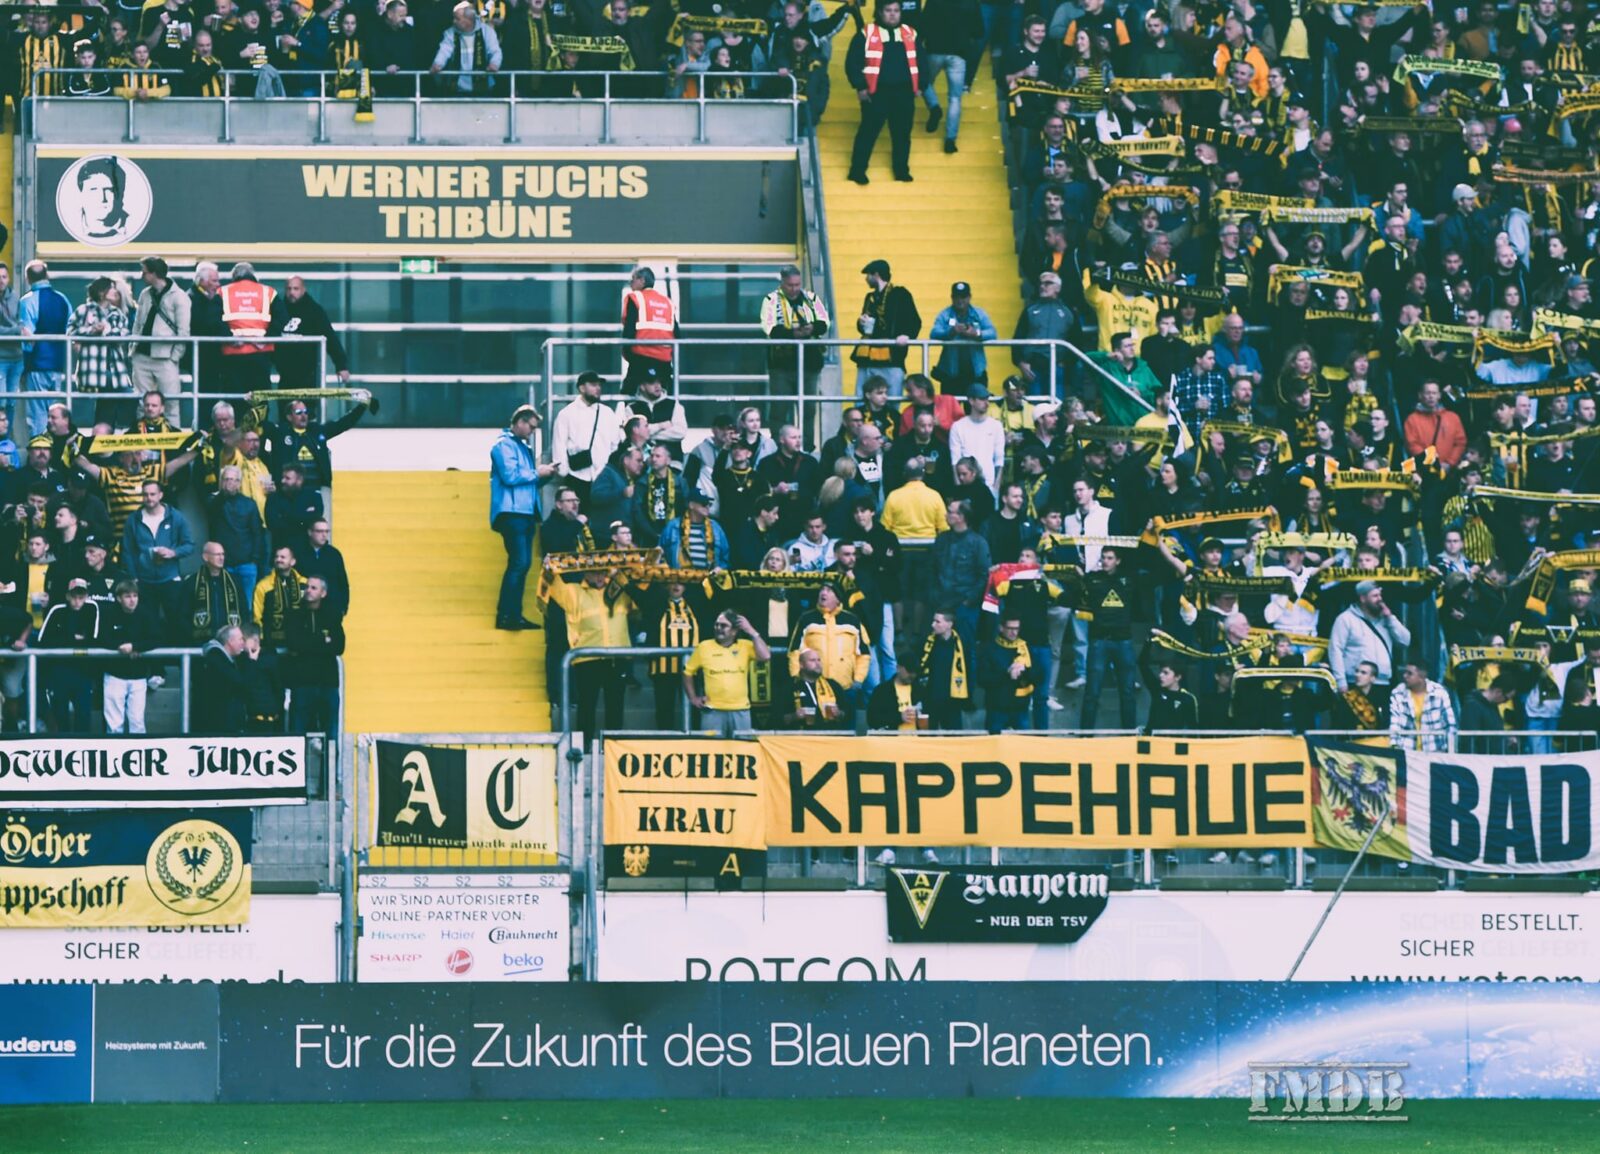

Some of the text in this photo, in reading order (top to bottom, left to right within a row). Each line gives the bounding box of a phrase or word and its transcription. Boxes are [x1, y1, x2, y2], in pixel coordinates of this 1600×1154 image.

[302, 165, 649, 198] WERNER FUCHS
[379, 200, 572, 238] TRIBÜNE
[188, 745, 298, 778] JUNGS
[618, 753, 758, 780] OECHER
[394, 750, 531, 830] A C
[787, 740, 1306, 836] KAPPEHÄUE
[637, 806, 736, 834] KRAU
[1429, 762, 1592, 864] BAD
[0, 876, 130, 915] ppschaff
[371, 894, 540, 906] WIR SIND AUTORISIERTER
[492, 927, 558, 942] Bauknecht
[990, 916, 1020, 927] NUR
[1026, 916, 1054, 927] DER
[1061, 916, 1088, 927] TSV
[1481, 914, 1583, 931] BESTELLT.
[64, 942, 141, 959] SICHER
[370, 952, 544, 966] SHARP beko
[1400, 940, 1475, 957] SICHER
[0, 1036, 77, 1053] uderus
[105, 1041, 207, 1051] Heizsysteme mit Zukunft.
[295, 1022, 1164, 1068] Für die Zukunft des Blauen Planeten.
